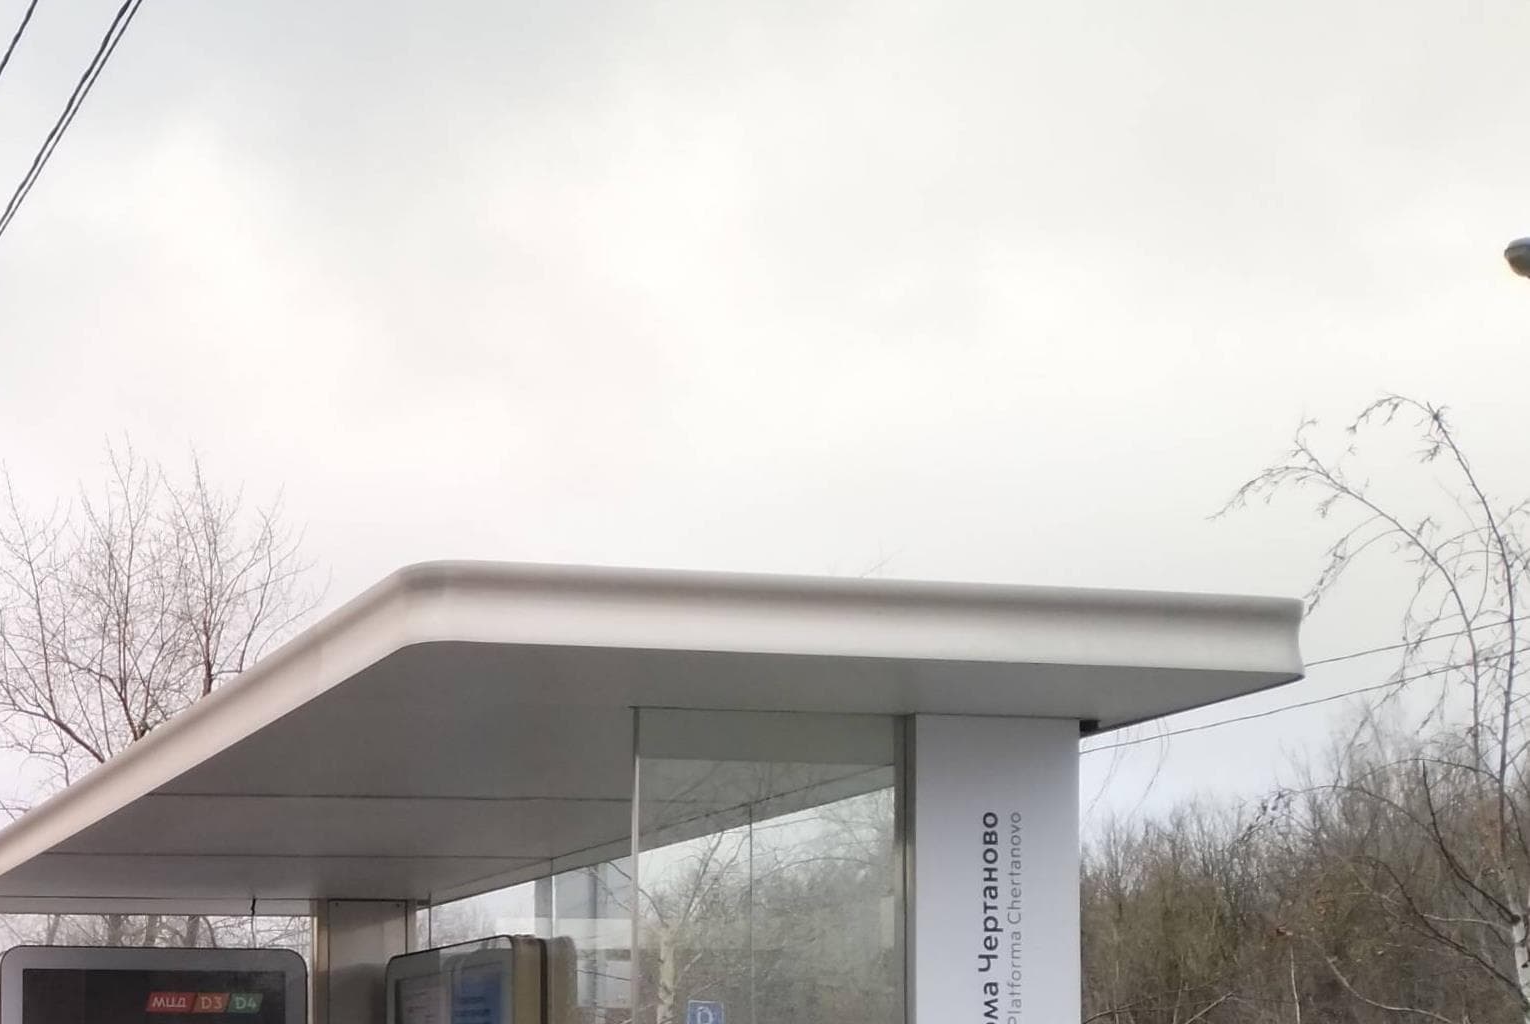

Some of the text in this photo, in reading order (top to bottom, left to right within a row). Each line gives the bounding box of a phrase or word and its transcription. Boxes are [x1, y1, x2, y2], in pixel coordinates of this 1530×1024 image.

[977, 811, 1004, 972] Чертаново
[1007, 811, 1022, 925] Chertanovo
[152, 996, 257, 1010] МЦД D3 D4
